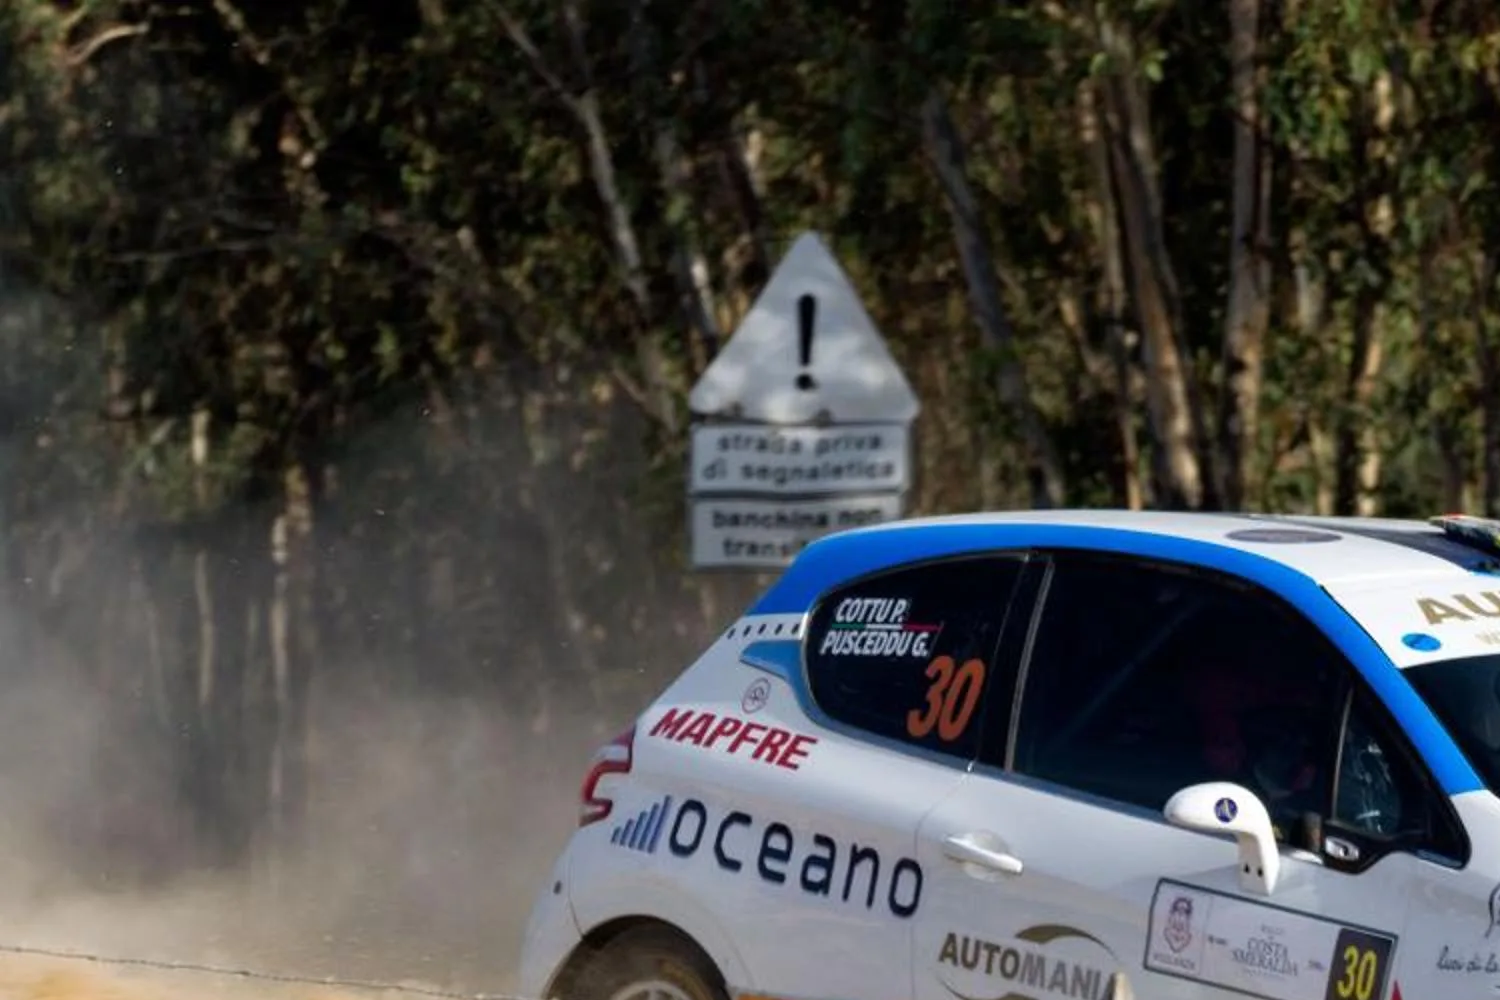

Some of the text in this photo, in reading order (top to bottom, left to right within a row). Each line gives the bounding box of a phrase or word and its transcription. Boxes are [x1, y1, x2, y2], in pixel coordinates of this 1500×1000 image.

[718, 433, 881, 457] strada priva
[703, 458, 894, 487] di segnaletica
[712, 510, 828, 529] banchina
[835, 598, 891, 622] COTTU
[820, 630, 929, 657] PUSCEDDU G.
[907, 655, 985, 741] 30
[650, 707, 819, 770] MAPFRE
